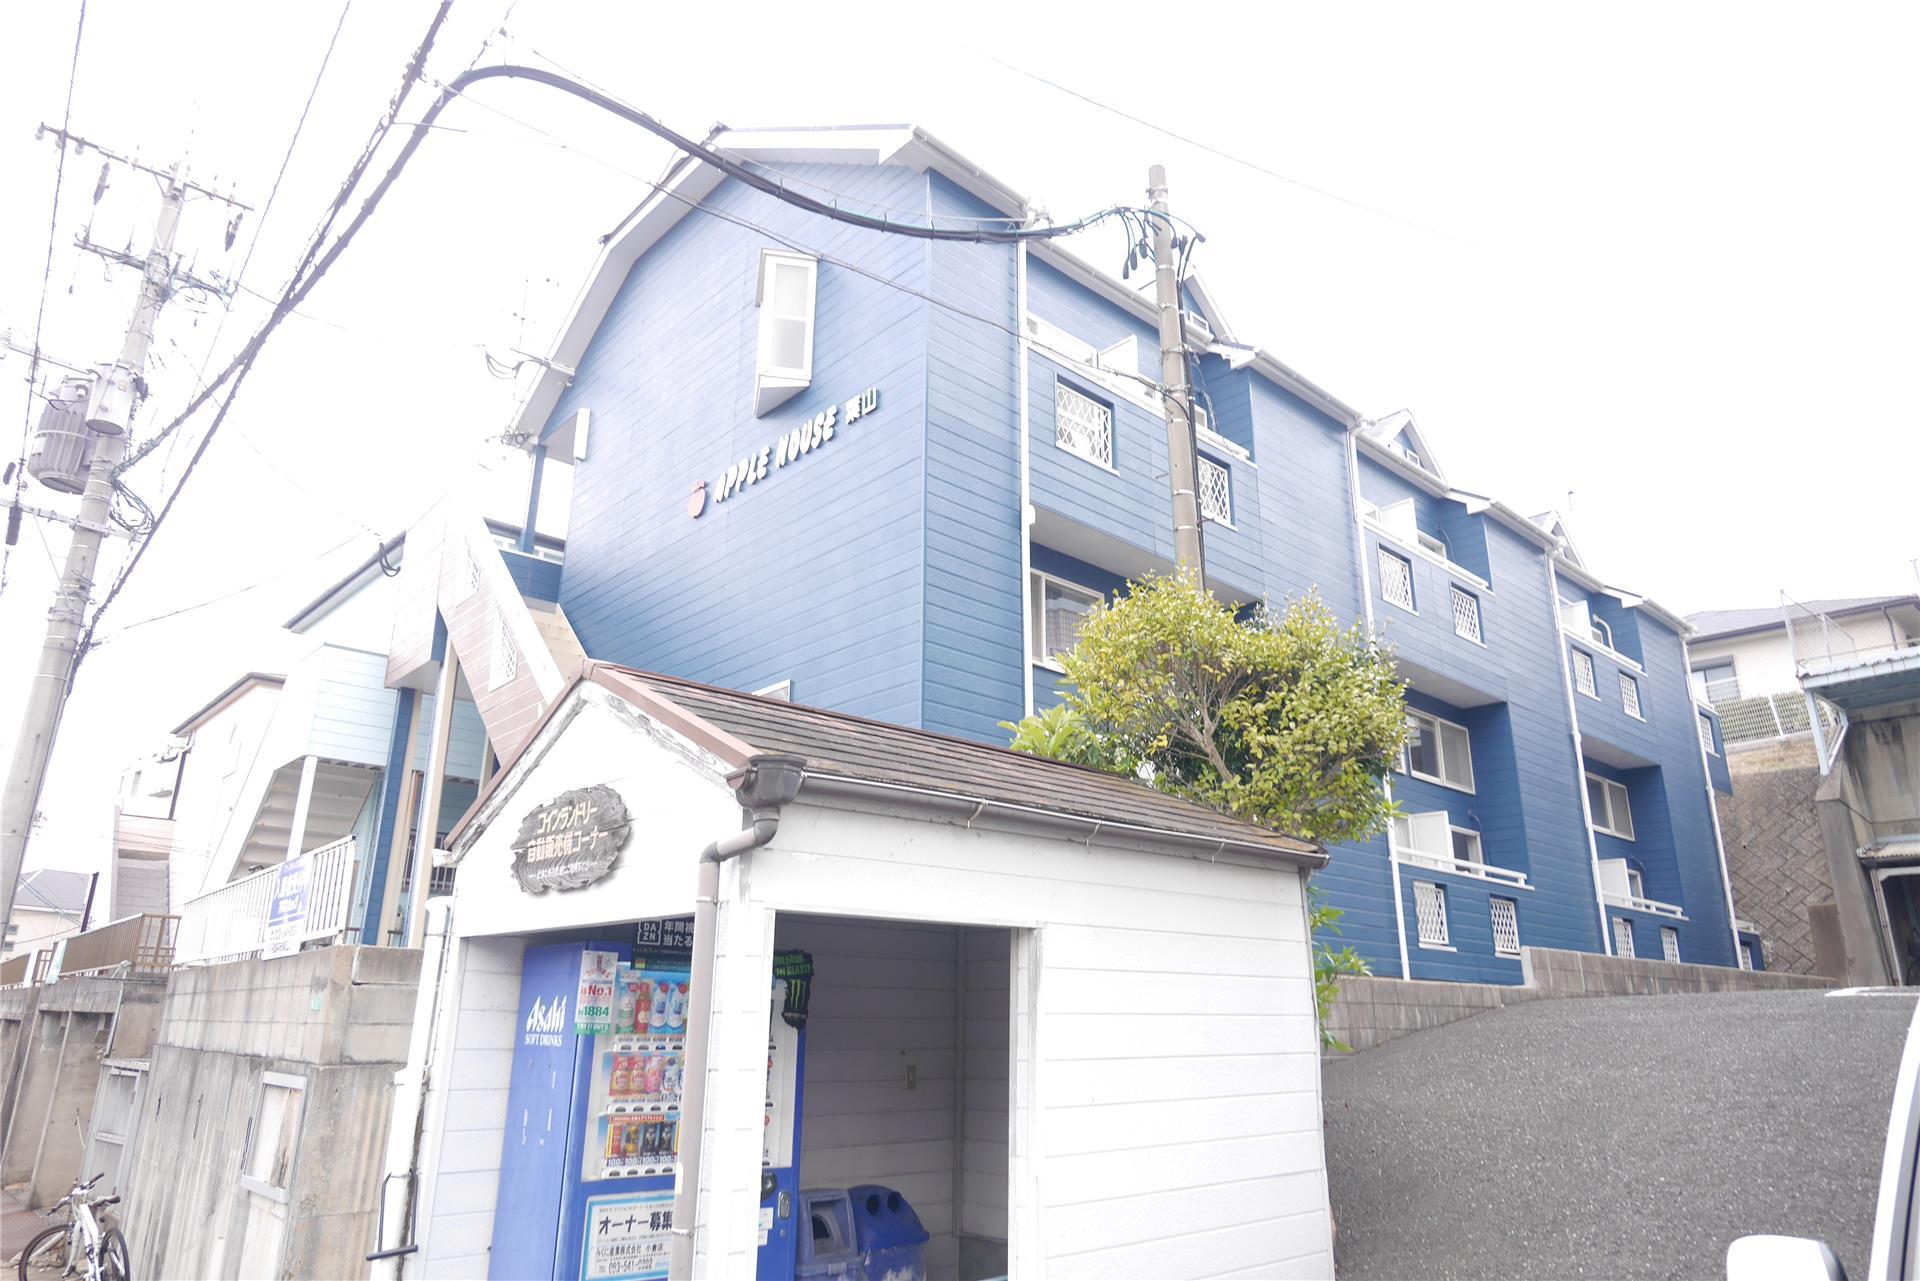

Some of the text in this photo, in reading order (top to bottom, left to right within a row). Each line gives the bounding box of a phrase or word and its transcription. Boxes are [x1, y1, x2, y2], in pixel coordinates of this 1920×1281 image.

[714, 446, 770, 503] APPLE
[775, 404, 837, 468] HOUSE
[537, 800, 598, 833] コインランドリー
[527, 825, 608, 863] 自動販売機コーナー
[663, 934, 693, 947] 当たる
[588, 985, 612, 996] No.1
[526, 995, 567, 1033] Asahi
[584, 1005, 609, 1017] 1884
[524, 1034, 562, 1047] SOFT DRINKS
[598, 1210, 673, 1235] オーナー募集
